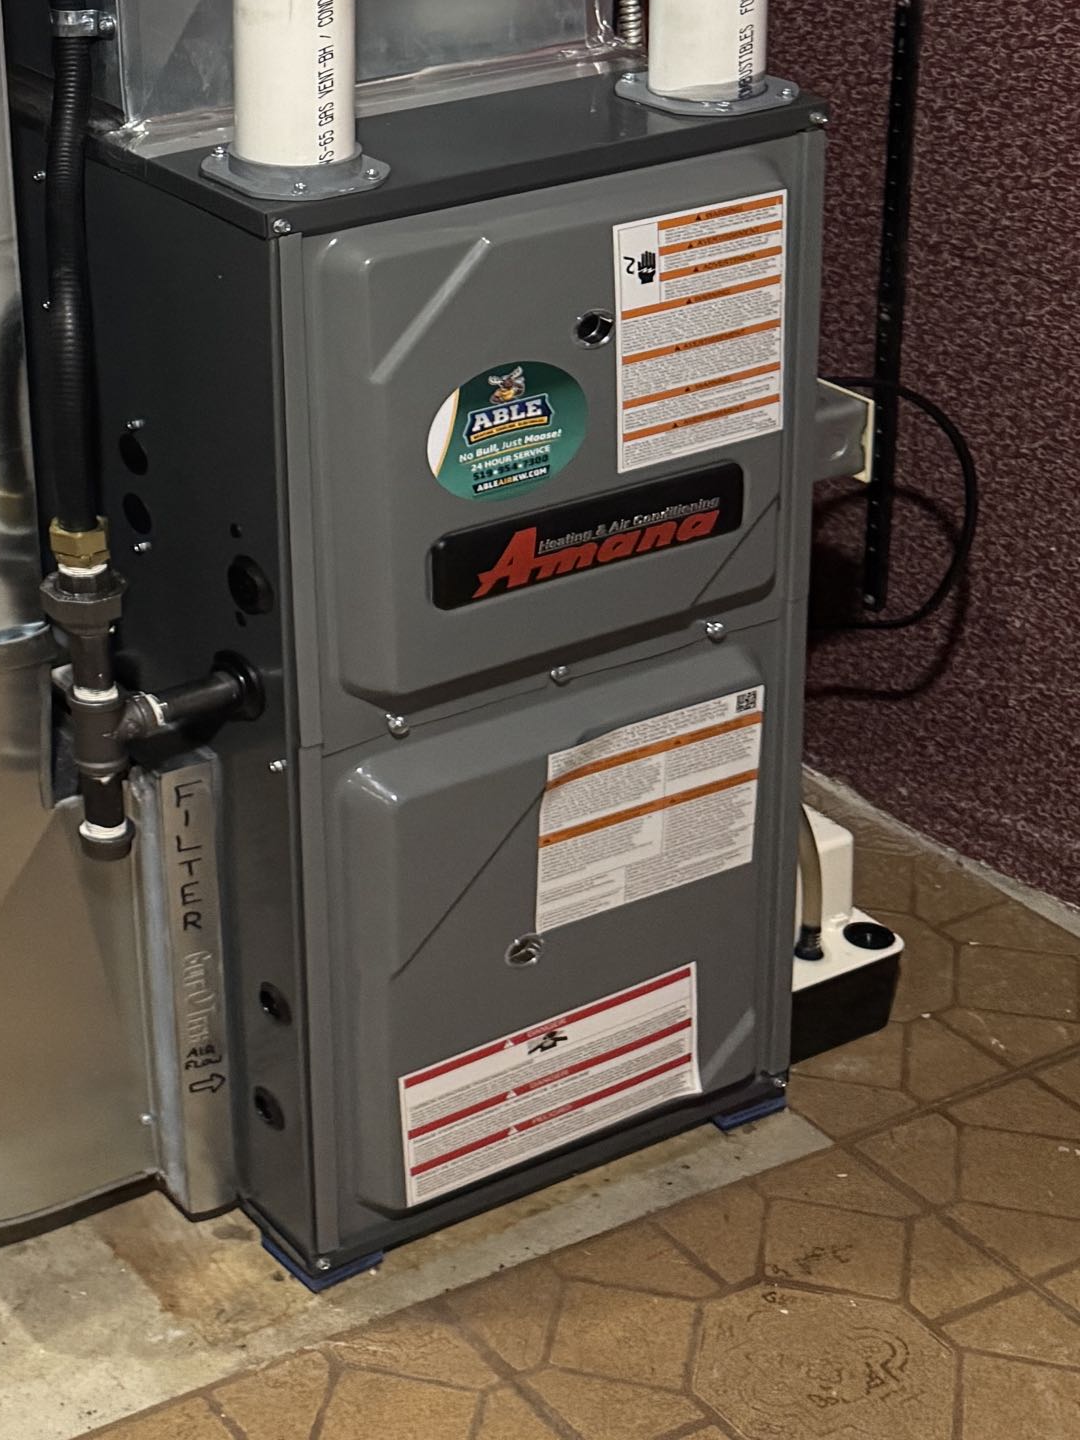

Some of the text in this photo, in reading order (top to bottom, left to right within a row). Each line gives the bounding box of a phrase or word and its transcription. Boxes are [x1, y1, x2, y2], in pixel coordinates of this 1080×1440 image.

[317, 45, 335, 98] VENT-BH
[317, 102, 335, 126] GAS
[472, 399, 542, 432] ABLE
[459, 452, 474, 463] No
[476, 445, 499, 458] Bull,
[501, 438, 522, 451] Just
[524, 429, 562, 445] Moose!
[471, 444, 551, 472] 24 HOUR SERVICE
[476, 467, 547, 492] ABLEAIRKW.COM
[538, 529, 593, 554] Heating
[609, 517, 629, 533] Air
[633, 497, 720, 527] Conditioning
[471, 509, 720, 599] Amana
[174, 779, 204, 931] FILTER
